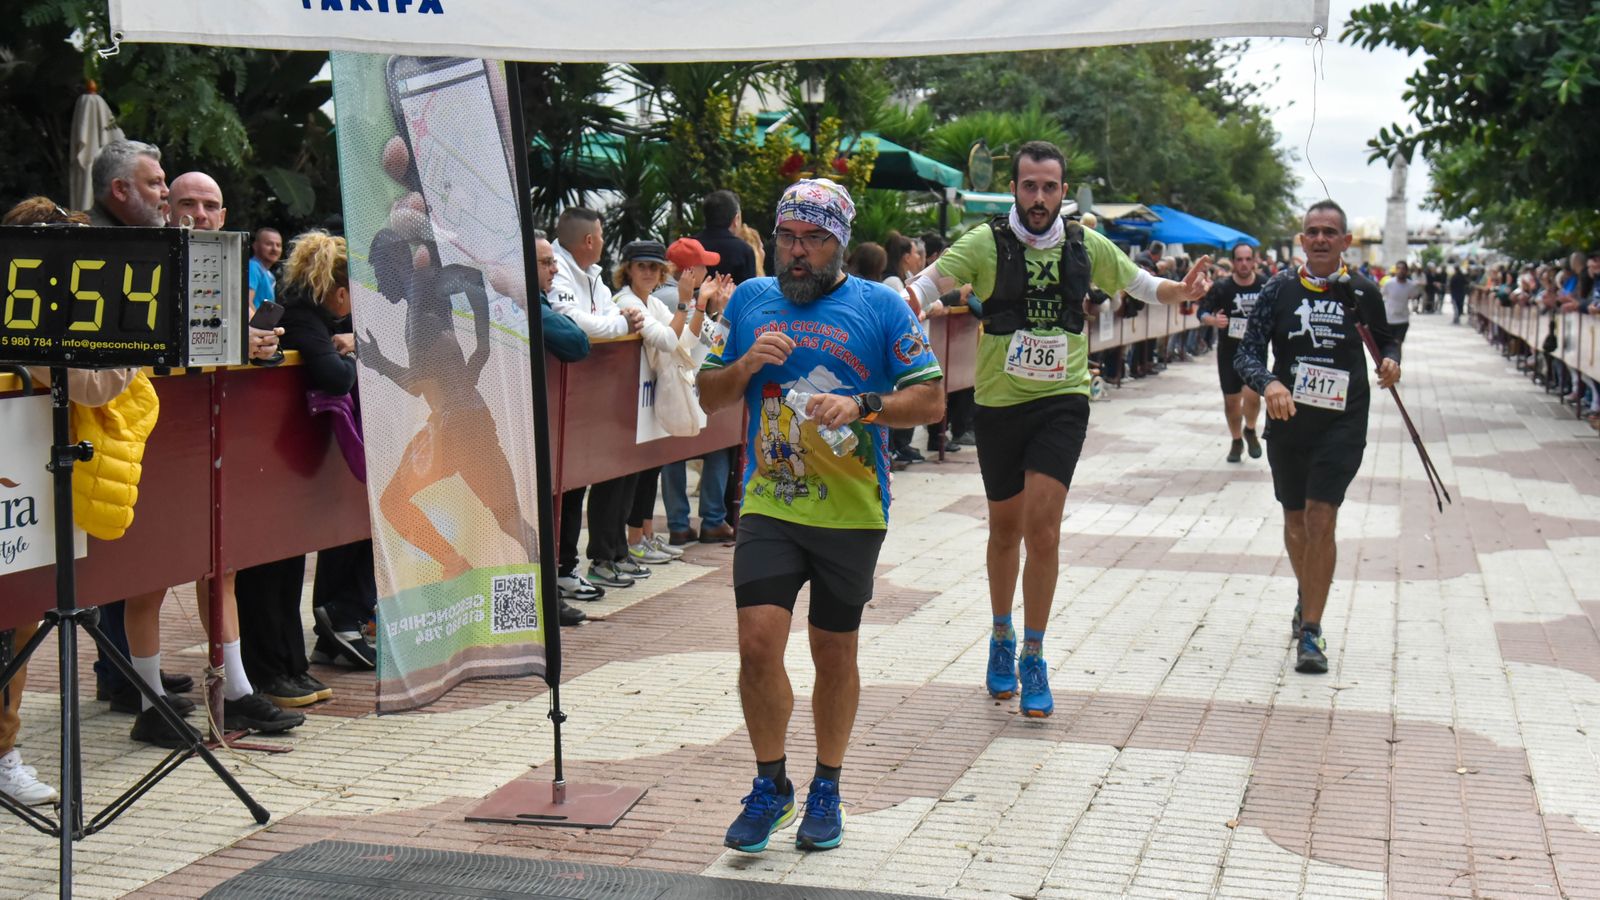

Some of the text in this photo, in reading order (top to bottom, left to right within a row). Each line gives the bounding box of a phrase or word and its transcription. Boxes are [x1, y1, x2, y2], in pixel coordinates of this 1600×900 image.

[4, 258, 162, 331] 6:54
[558, 292, 575, 302] HH
[754, 319, 849, 344] PEÑA CICLISTA
[11, 336, 30, 347] 980
[33, 337, 52, 347] 784
[61, 338, 166, 351] info@gesconchip.es
[1023, 335, 1040, 347] XIV
[794, 334, 871, 381] LAS PIERNAS
[1024, 347, 1055, 366] 136
[1307, 367, 1322, 377] XIV
[1307, 376, 1336, 394] 417
[0, 536, 30, 565] tyle
